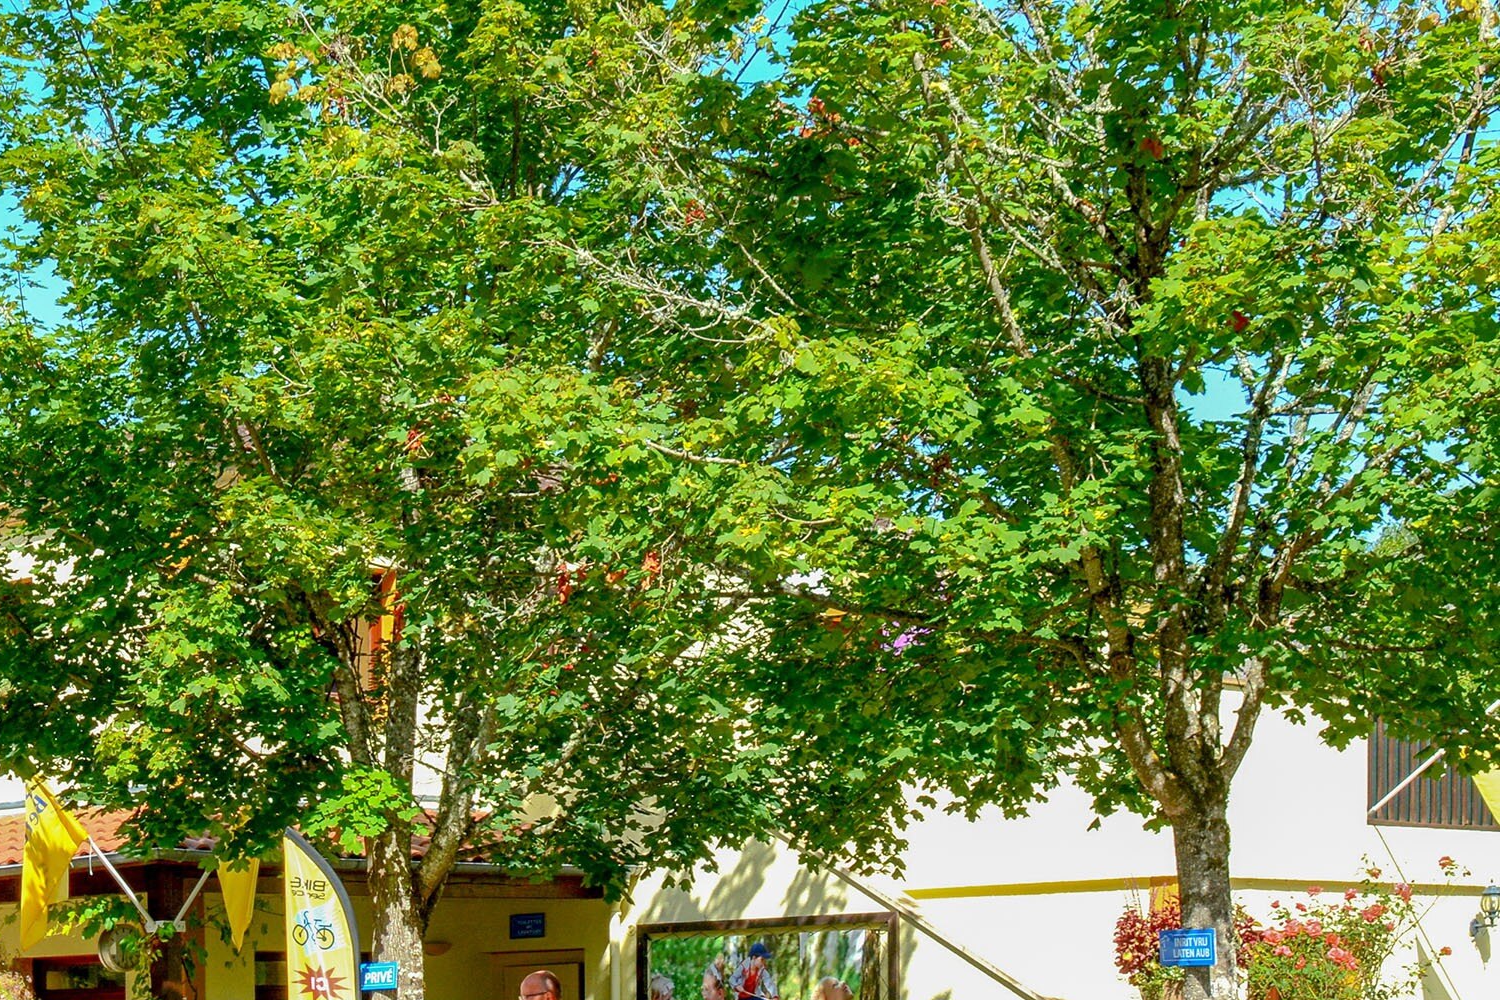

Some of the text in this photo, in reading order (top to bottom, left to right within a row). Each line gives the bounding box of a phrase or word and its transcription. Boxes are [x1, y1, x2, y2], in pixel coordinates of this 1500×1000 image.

[1174, 937, 1192, 947] INRIT
[1173, 948, 1210, 958] LATEN AUB
[364, 967, 393, 985] PRIVÉ
